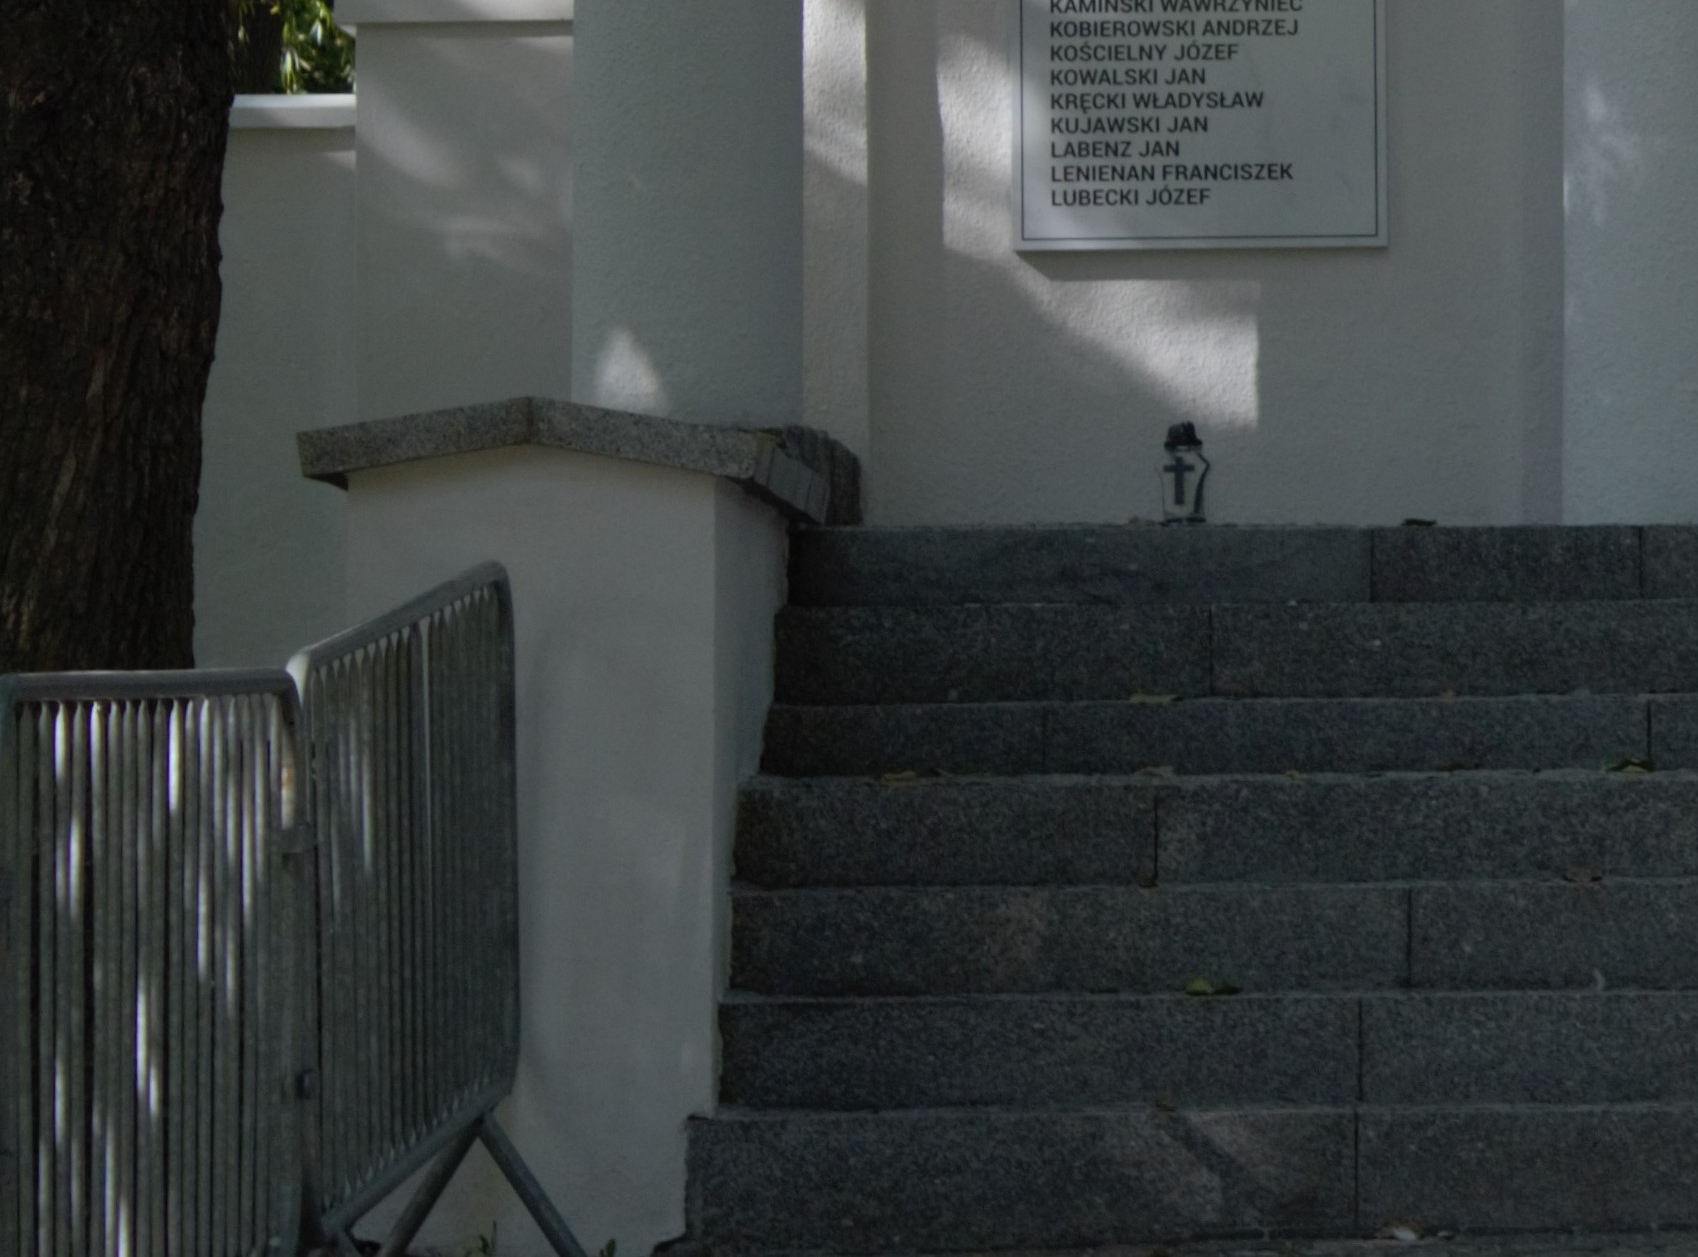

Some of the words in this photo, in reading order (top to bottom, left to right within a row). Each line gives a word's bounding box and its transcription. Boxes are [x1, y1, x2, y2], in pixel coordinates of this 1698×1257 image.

[1051, 20, 1195, 37] KOBIEROWSKI
[1202, 19, 1299, 36] ANDRZEJ
[1051, 40, 1166, 61] KOŚCIELNY
[1174, 39, 1239, 61] JÓZEF
[1051, 69, 1158, 85] KOWALSKI
[1165, 68, 1206, 85] JAN
[1051, 93, 1126, 114] KRĘCKI
[1134, 92, 1264, 109] WŁADYSŁAW
[1051, 117, 1160, 134] KUJAWSKI
[1168, 116, 1208, 133] JAN
[1051, 141, 1131, 158] LABENZ
[1139, 141, 1180, 157] JAN
[1051, 165, 1154, 182] LENIENAN
[1162, 164, 1293, 181] FRANCISZEK
[1051, 189, 1139, 206] LUBECKI
[1146, 185, 1211, 205] JÓZEF
